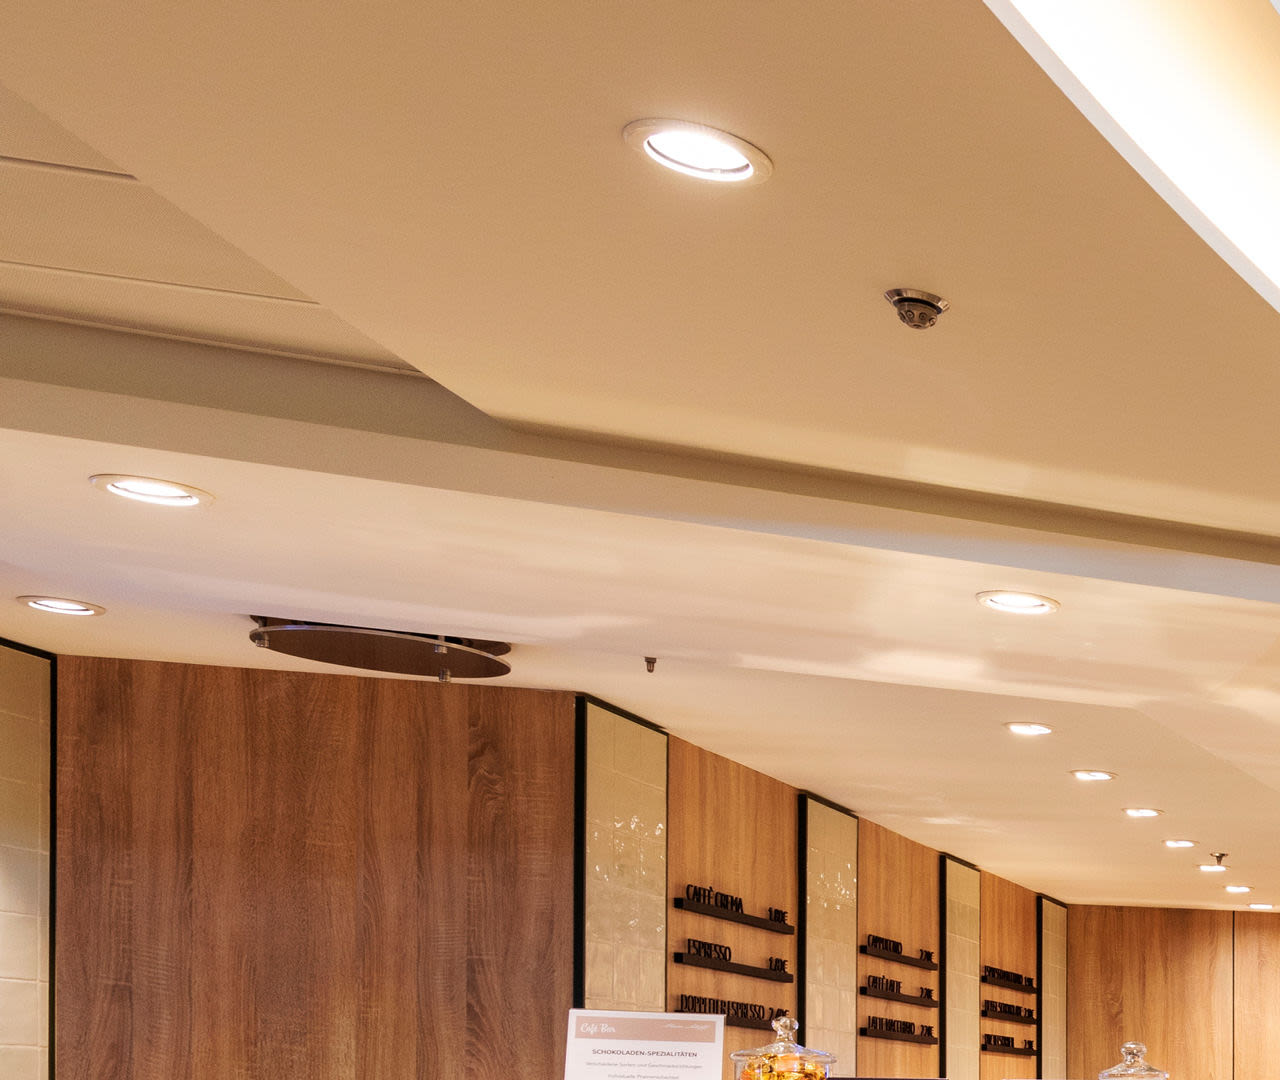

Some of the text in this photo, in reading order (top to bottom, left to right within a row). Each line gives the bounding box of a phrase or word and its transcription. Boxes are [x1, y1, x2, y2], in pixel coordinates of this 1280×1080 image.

[715, 892, 744, 914] CREMA
[687, 938, 732, 961] ESPRESSO
[680, 994, 726, 1016] DOPPELTER
[726, 1000, 765, 1021] ESPRESSO
[592, 1049, 697, 1057] SCHOKOLADEN-SPEZIALITÄTEN
